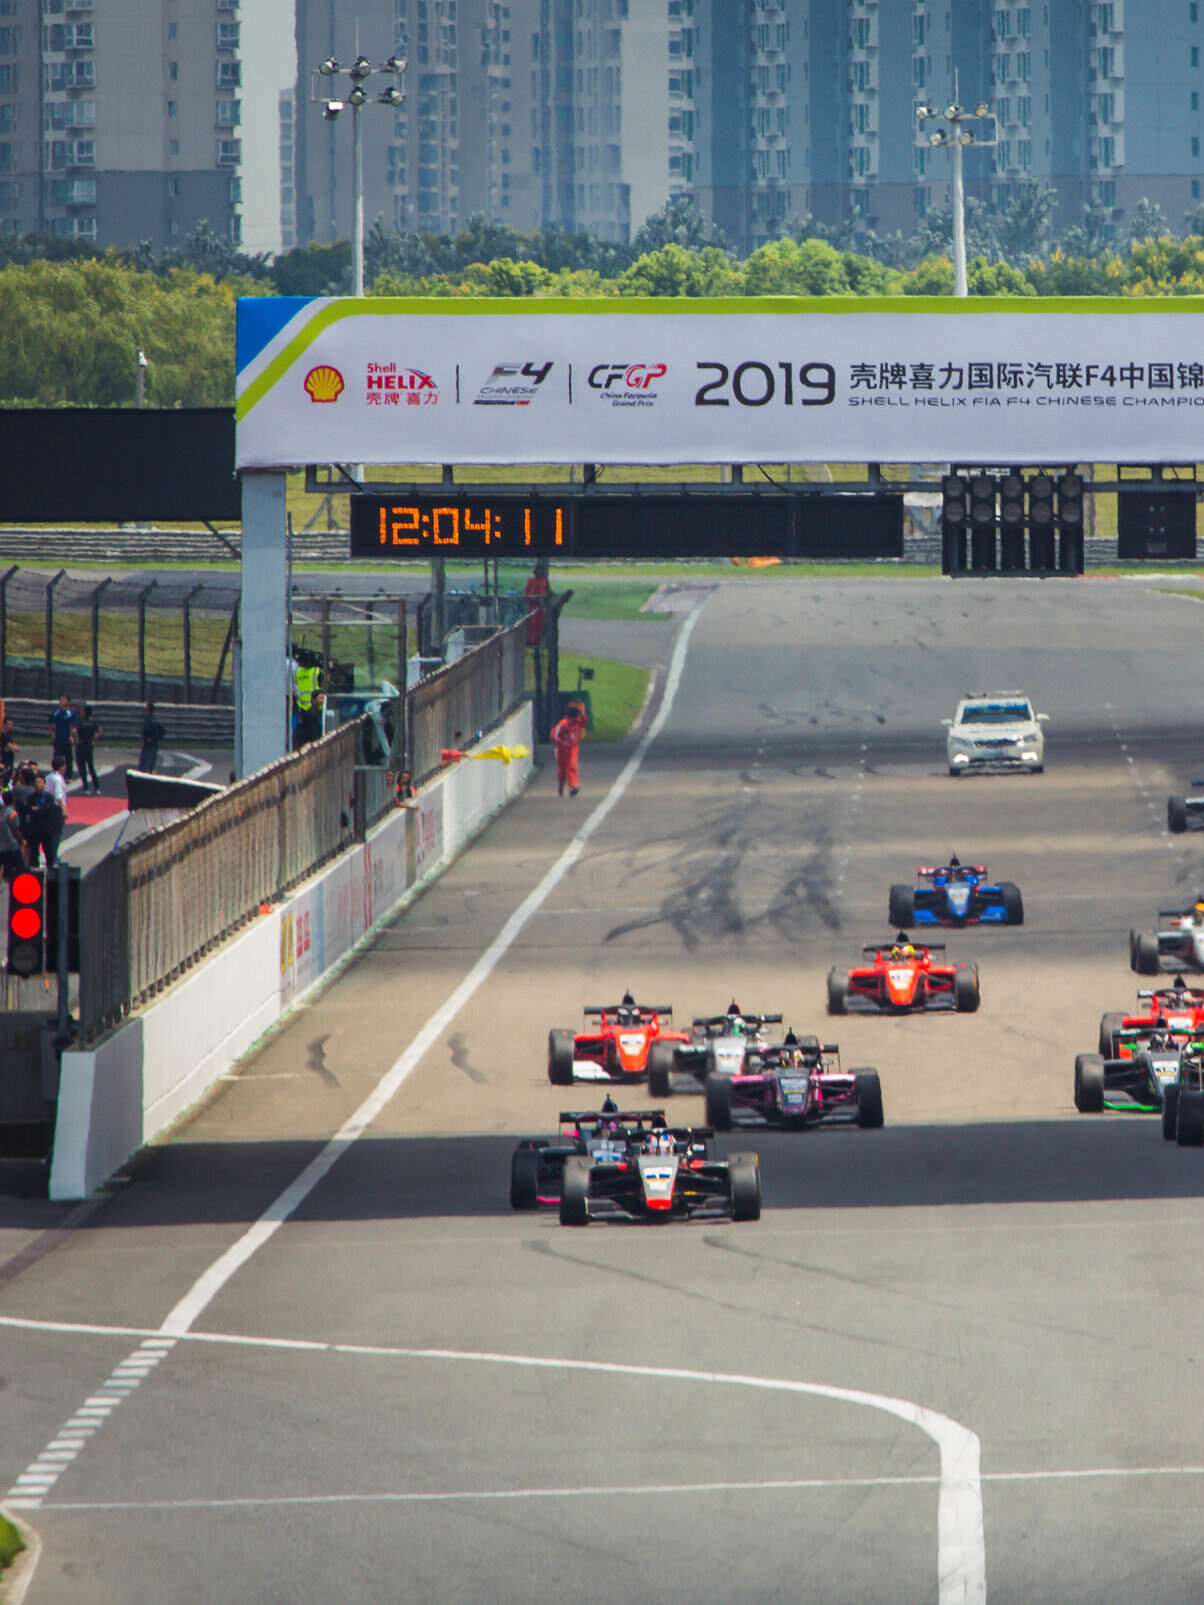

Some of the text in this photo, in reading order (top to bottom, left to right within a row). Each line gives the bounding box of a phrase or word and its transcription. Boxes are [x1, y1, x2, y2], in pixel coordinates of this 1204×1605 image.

[367, 362, 396, 373] Shell
[487, 362, 554, 385] F4
[588, 363, 667, 389] CFGP
[367, 374, 436, 390] HELIX
[695, 361, 836, 406] 2019
[848, 396, 909, 406] SHELL
[915, 396, 966, 407] HELIX
[973, 397, 1001, 406] FIA
[1007, 396, 1030, 406] F4
[1036, 396, 1116, 406] CHINESE
